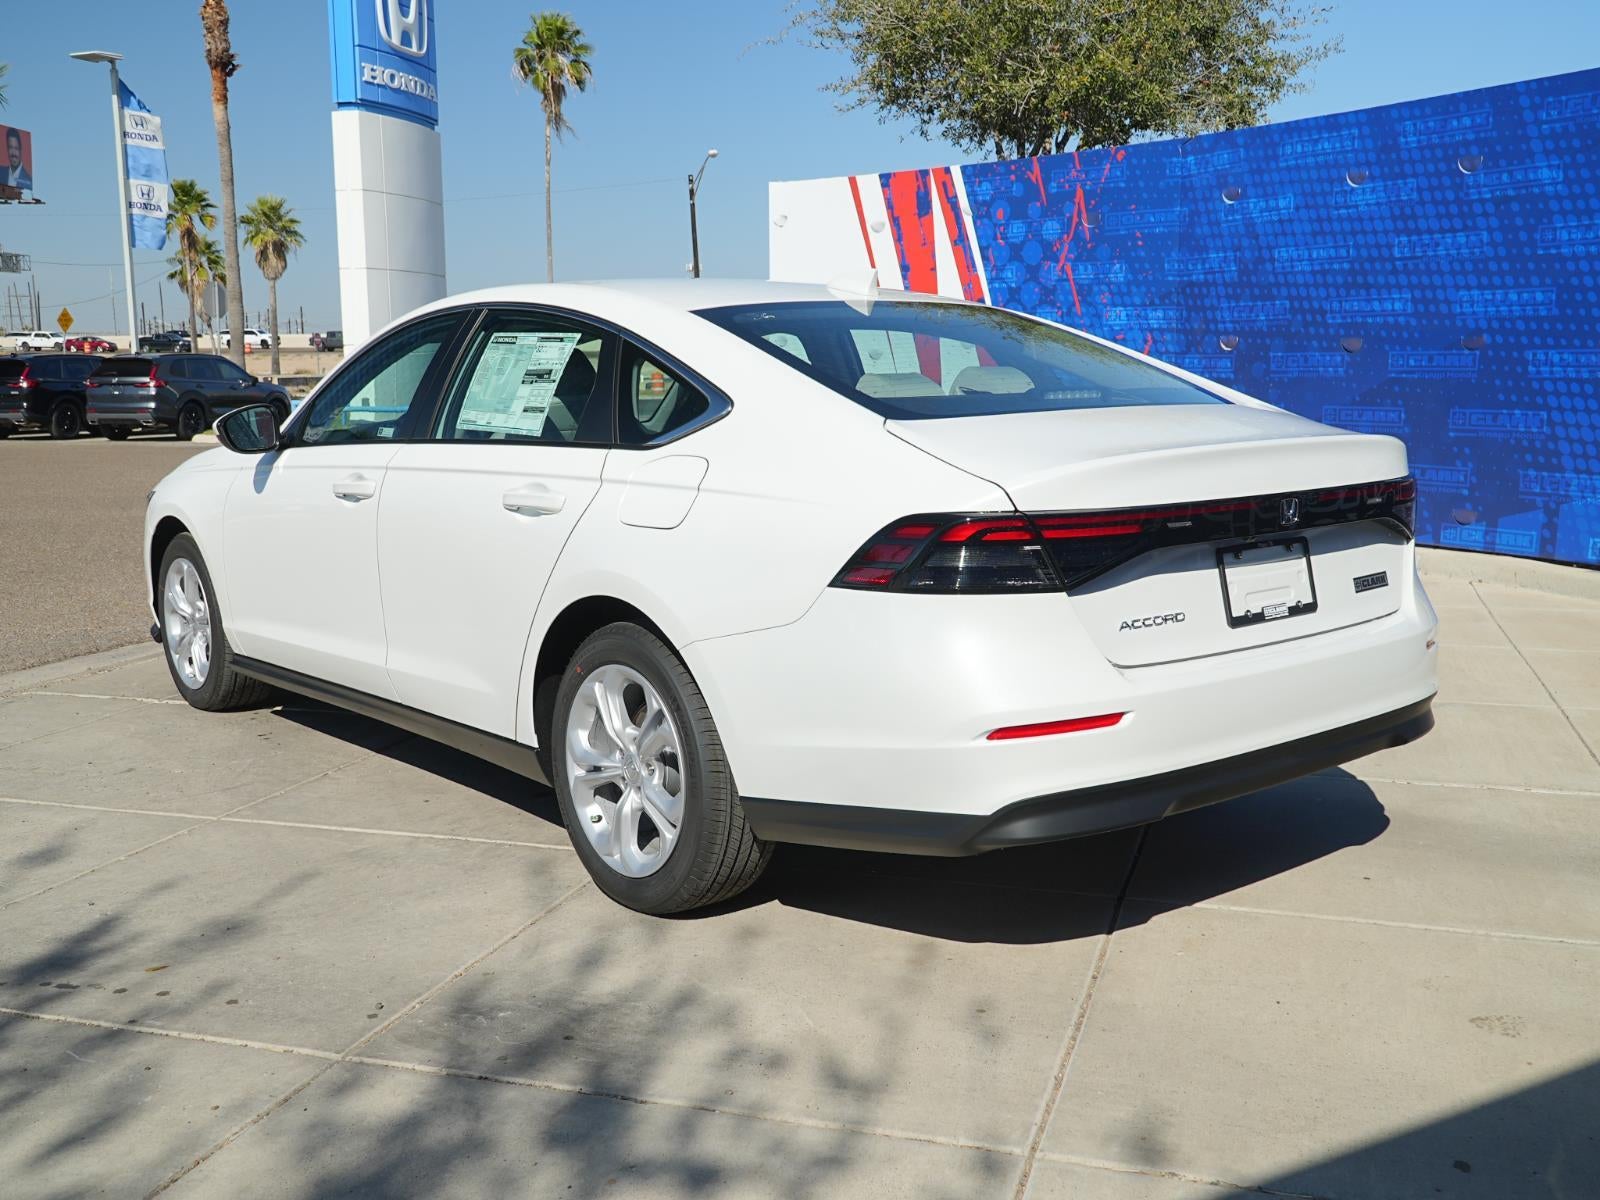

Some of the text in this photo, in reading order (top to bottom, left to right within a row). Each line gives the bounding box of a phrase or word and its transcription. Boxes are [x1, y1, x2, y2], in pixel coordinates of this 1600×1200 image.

[361, 62, 437, 103] HONDA
[123, 131, 159, 142] HONDA
[129, 201, 163, 213] HONDA
[1361, 574, 1387, 588] CLARK
[1119, 612, 1185, 632] ACCORD
